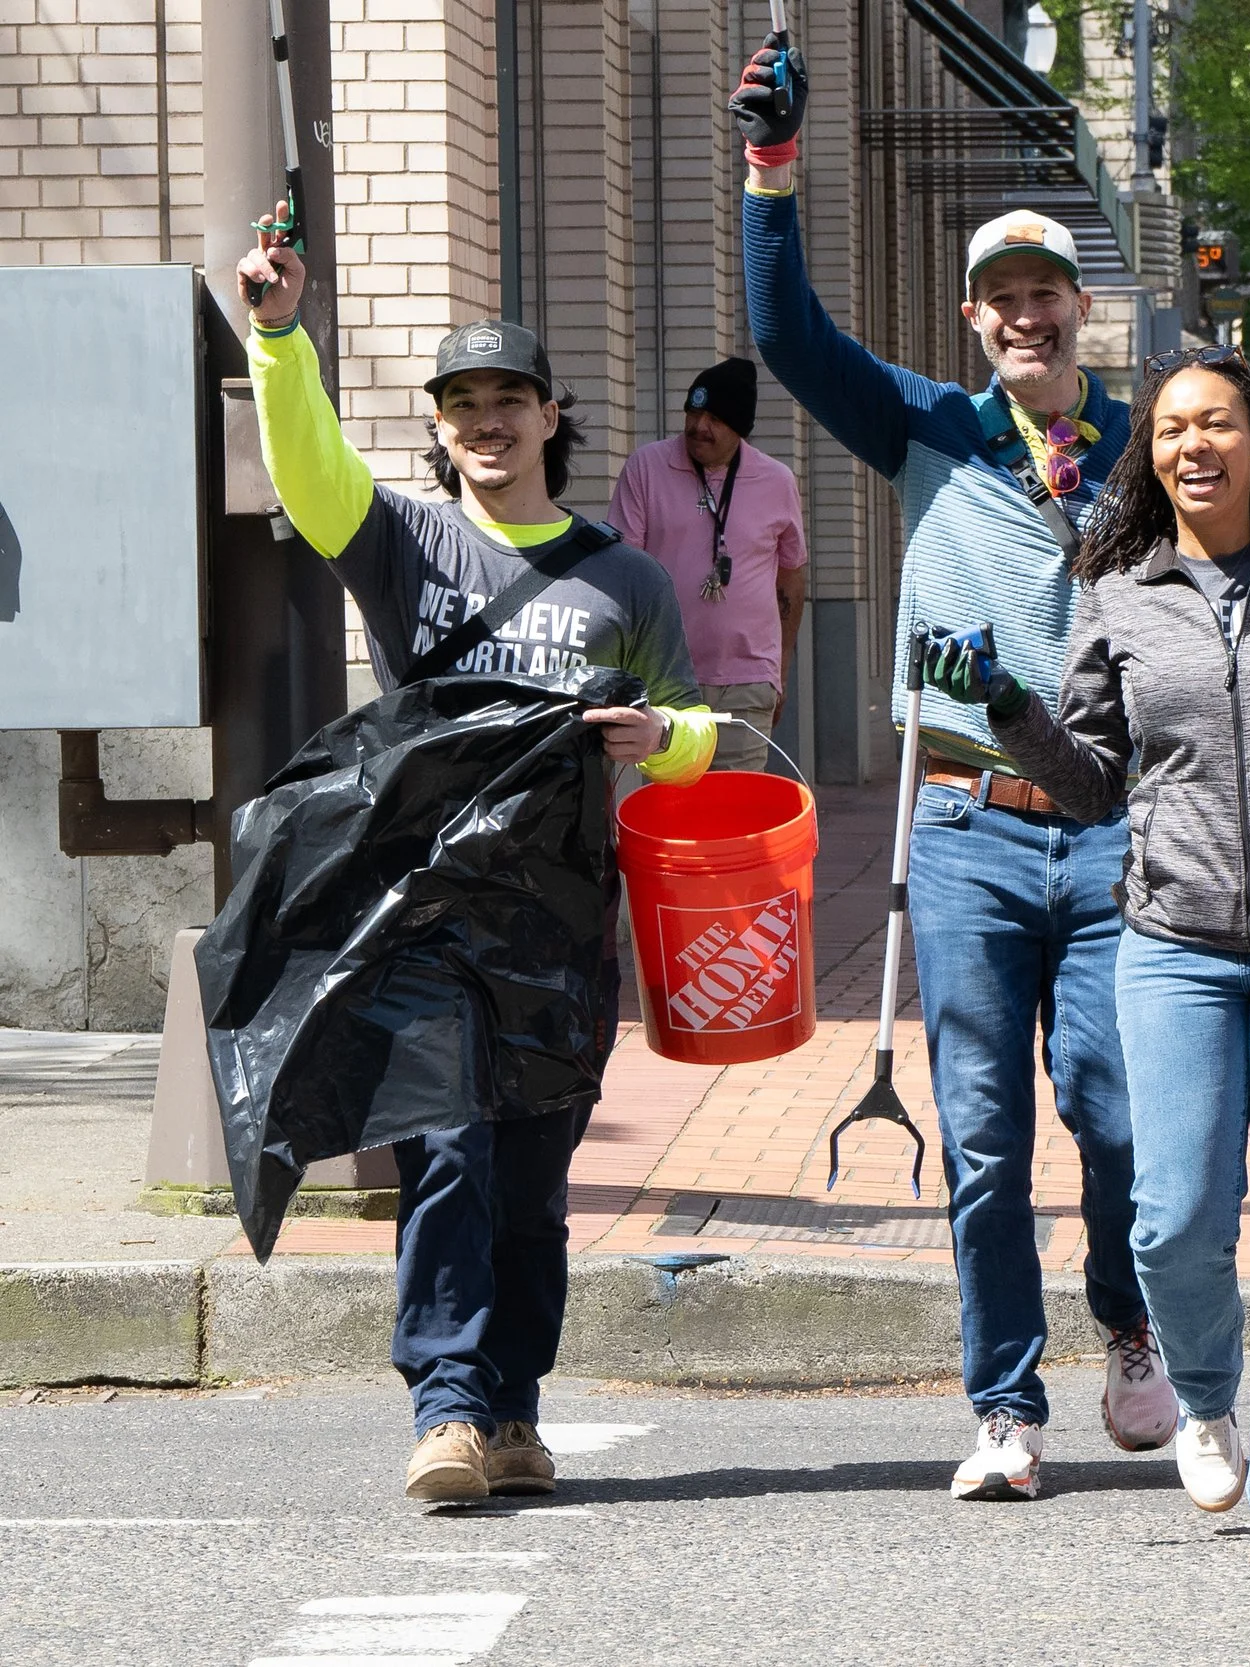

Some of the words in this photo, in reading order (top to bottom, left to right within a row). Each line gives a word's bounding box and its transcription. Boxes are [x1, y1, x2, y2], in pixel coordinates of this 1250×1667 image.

[418, 580, 460, 628] WE
[669, 899, 797, 1031] HOME
[675, 921, 737, 972] THE
[723, 939, 798, 1029] DEPOT
